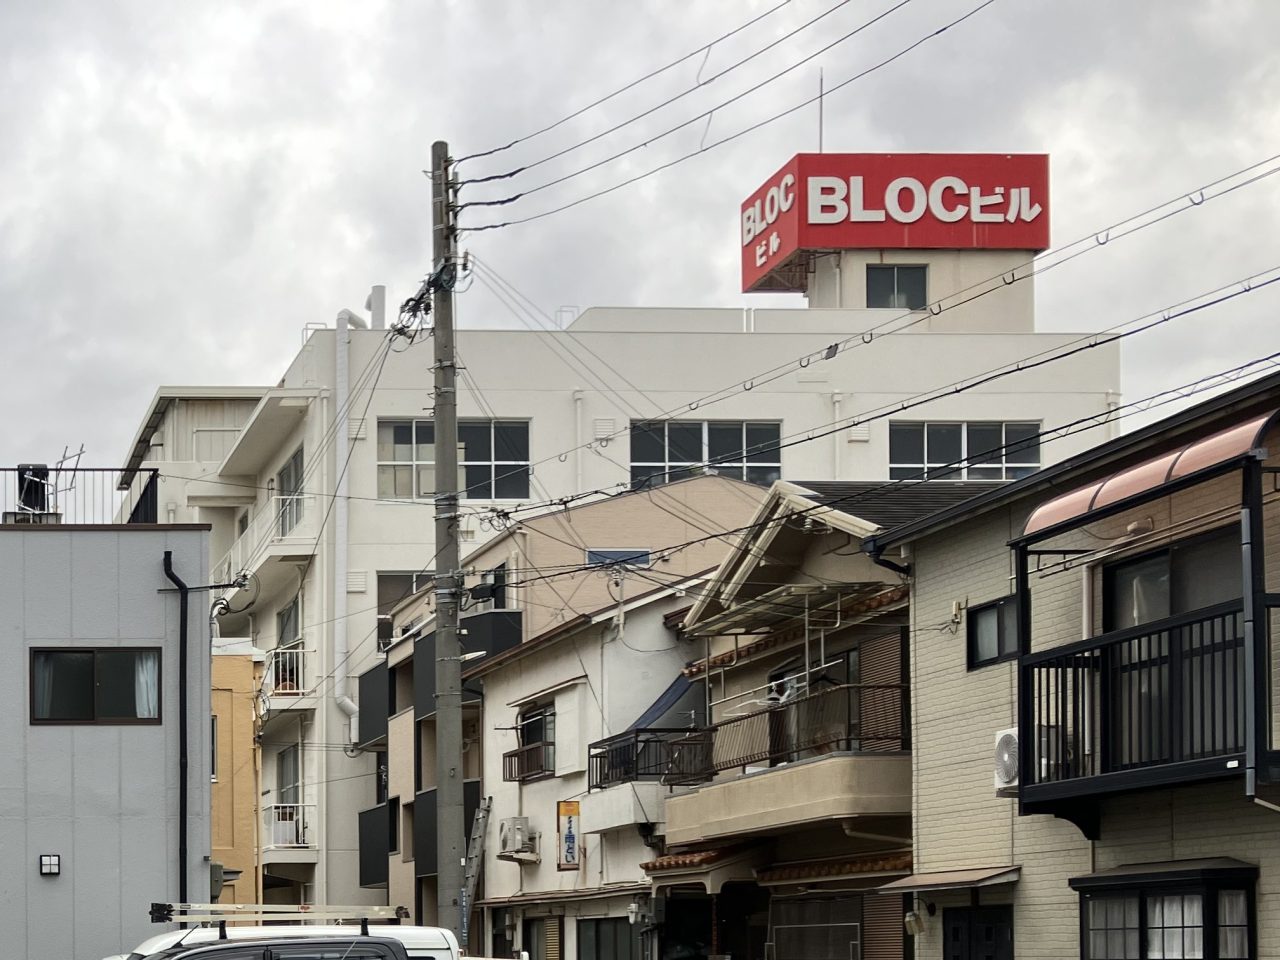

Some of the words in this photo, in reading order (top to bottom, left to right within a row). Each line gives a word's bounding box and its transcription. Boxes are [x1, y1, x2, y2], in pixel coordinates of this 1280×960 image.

[742, 173, 796, 247] BLOC
[807, 175, 1043, 225] BLOCビル
[755, 231, 782, 268] ビル
